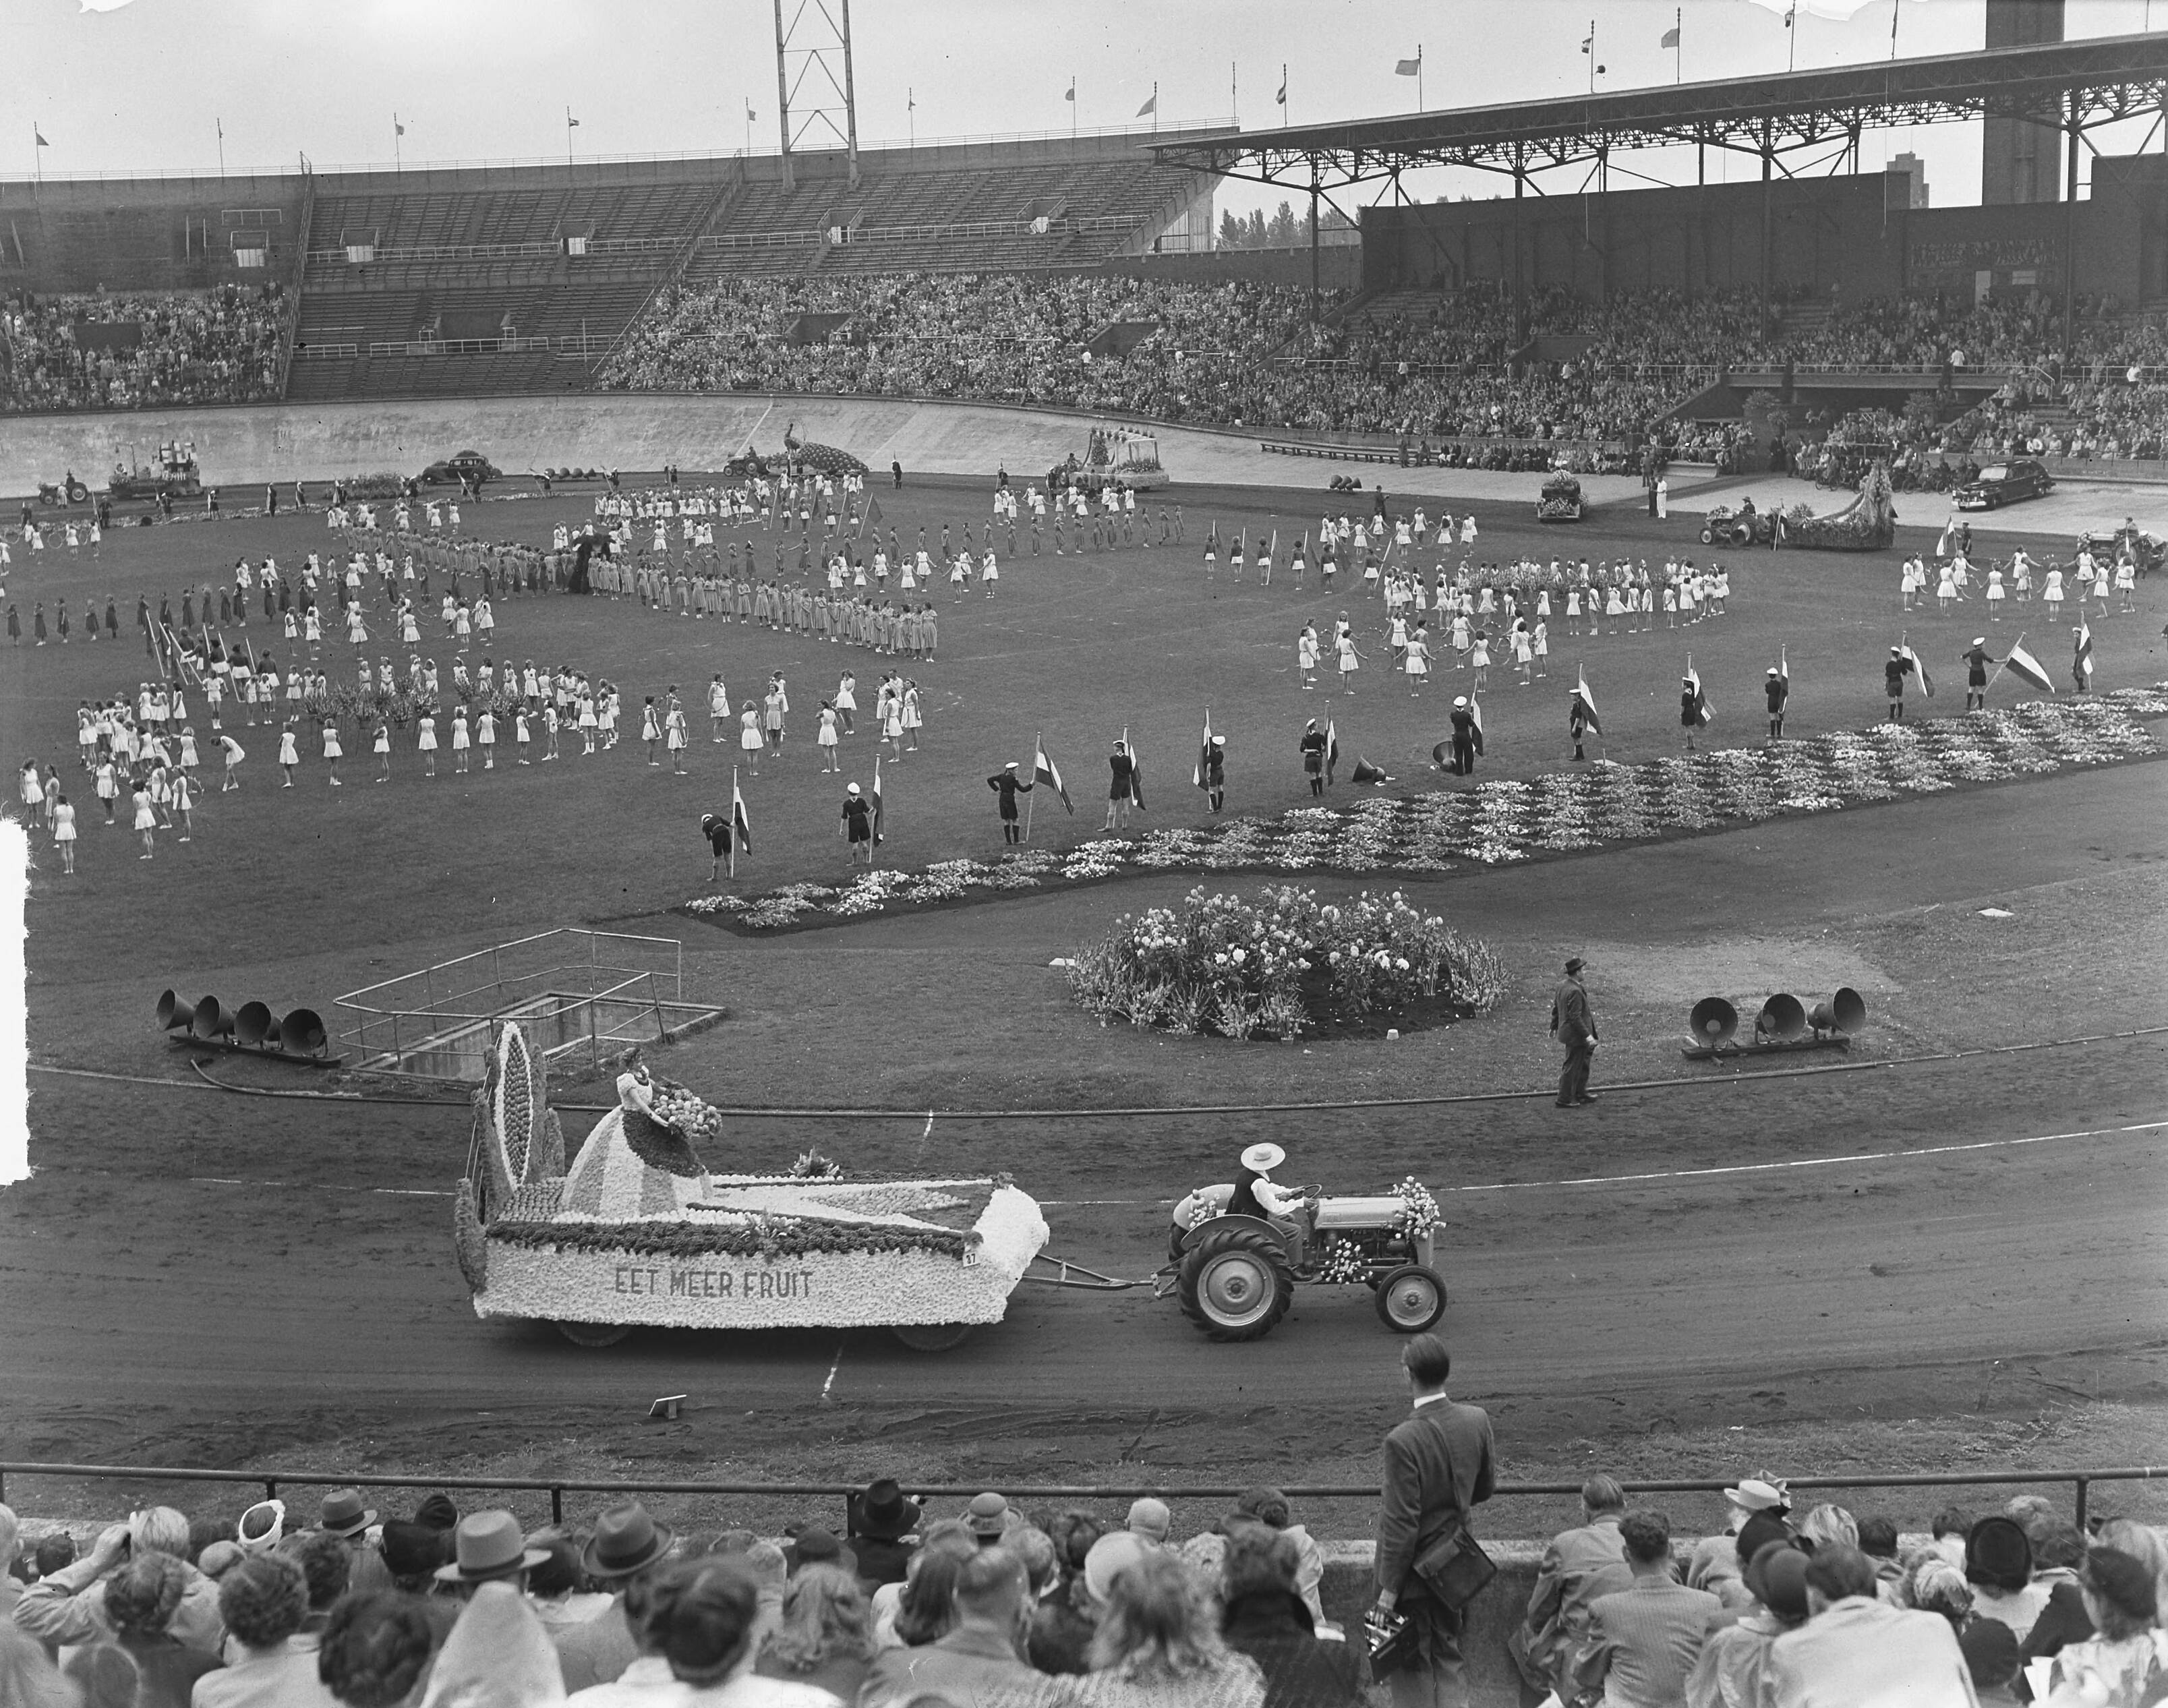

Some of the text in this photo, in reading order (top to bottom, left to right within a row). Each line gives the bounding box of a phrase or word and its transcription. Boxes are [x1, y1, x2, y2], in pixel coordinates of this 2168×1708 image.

[616, 1267, 813, 1298] EET MEER FRUIT
